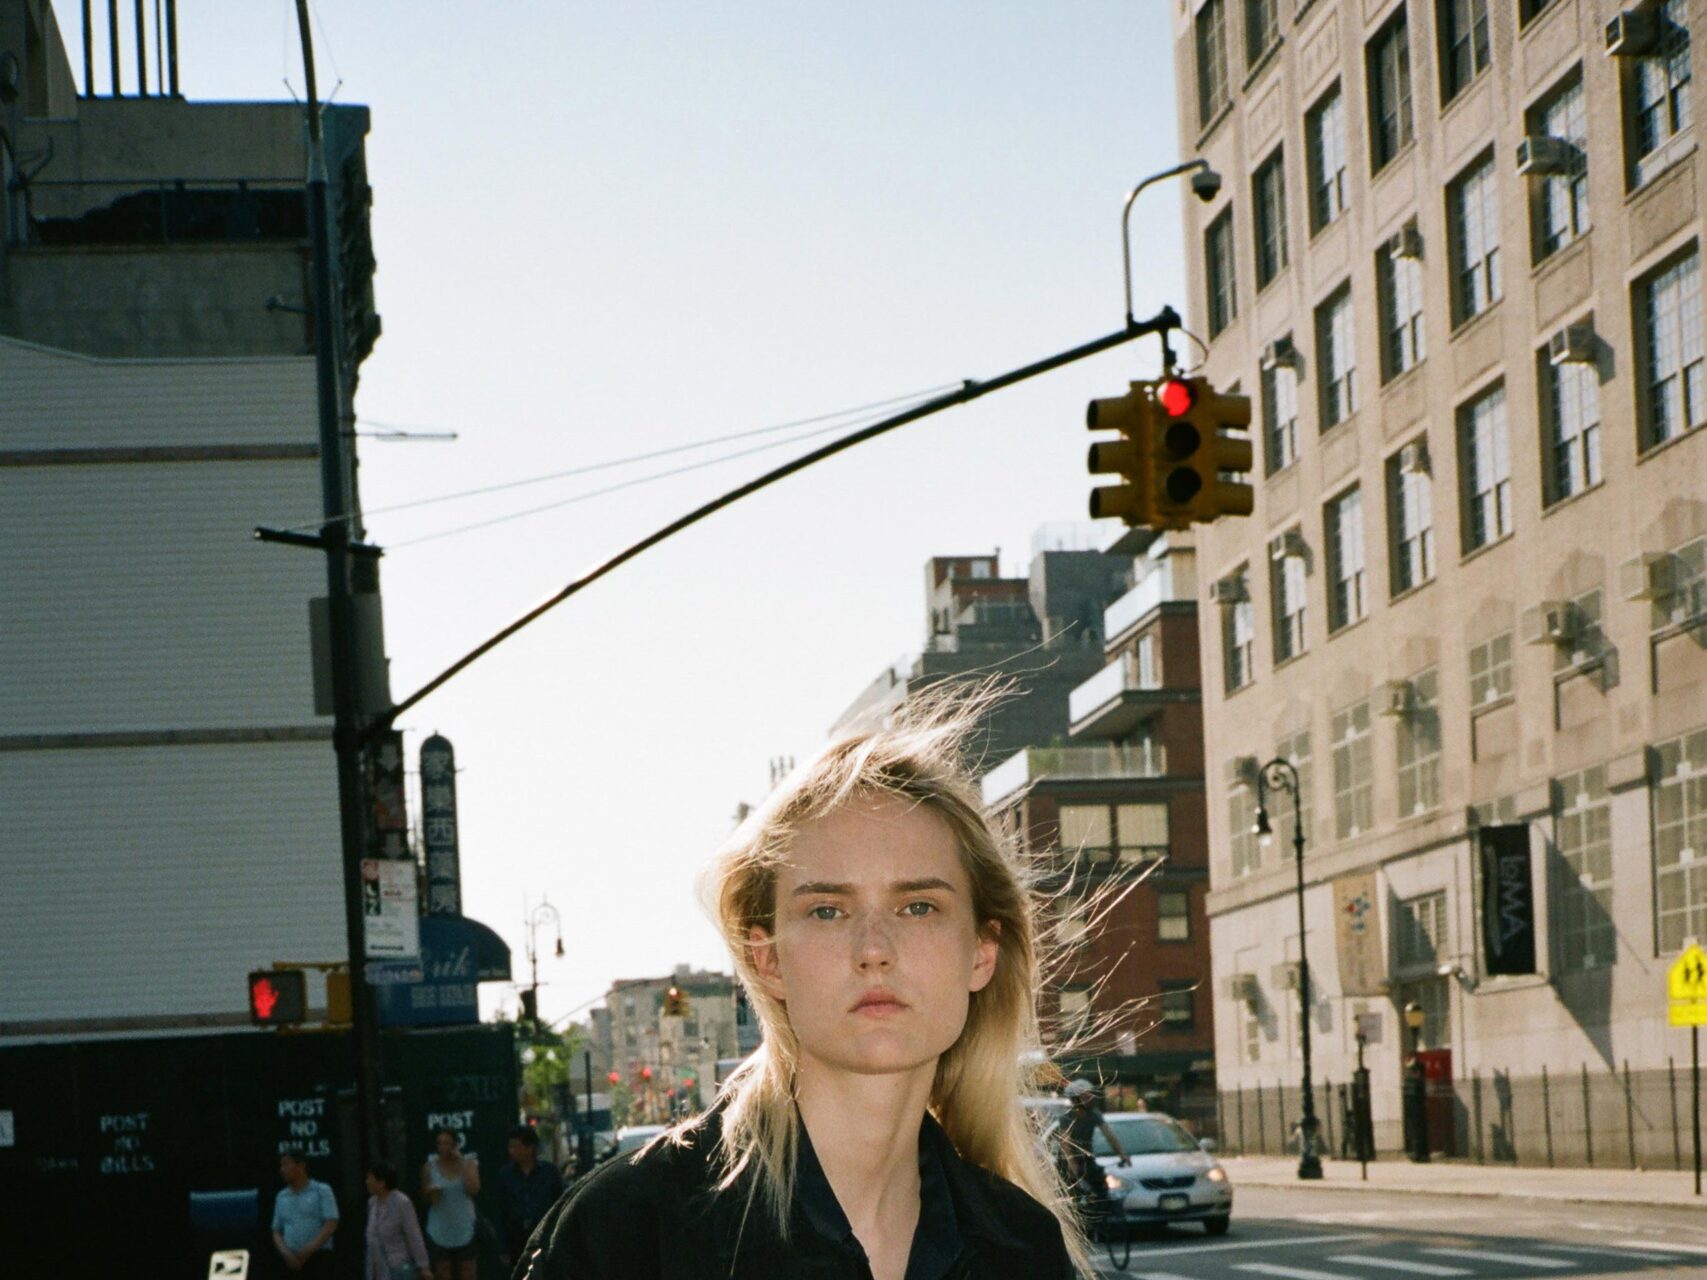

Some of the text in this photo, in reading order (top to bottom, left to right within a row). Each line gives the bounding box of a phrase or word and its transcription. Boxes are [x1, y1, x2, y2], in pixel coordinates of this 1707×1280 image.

[278, 1098, 326, 1117] POST
[100, 1112, 149, 1132] POST
[290, 1120, 317, 1136] NO
[427, 1110, 475, 1130] POST
